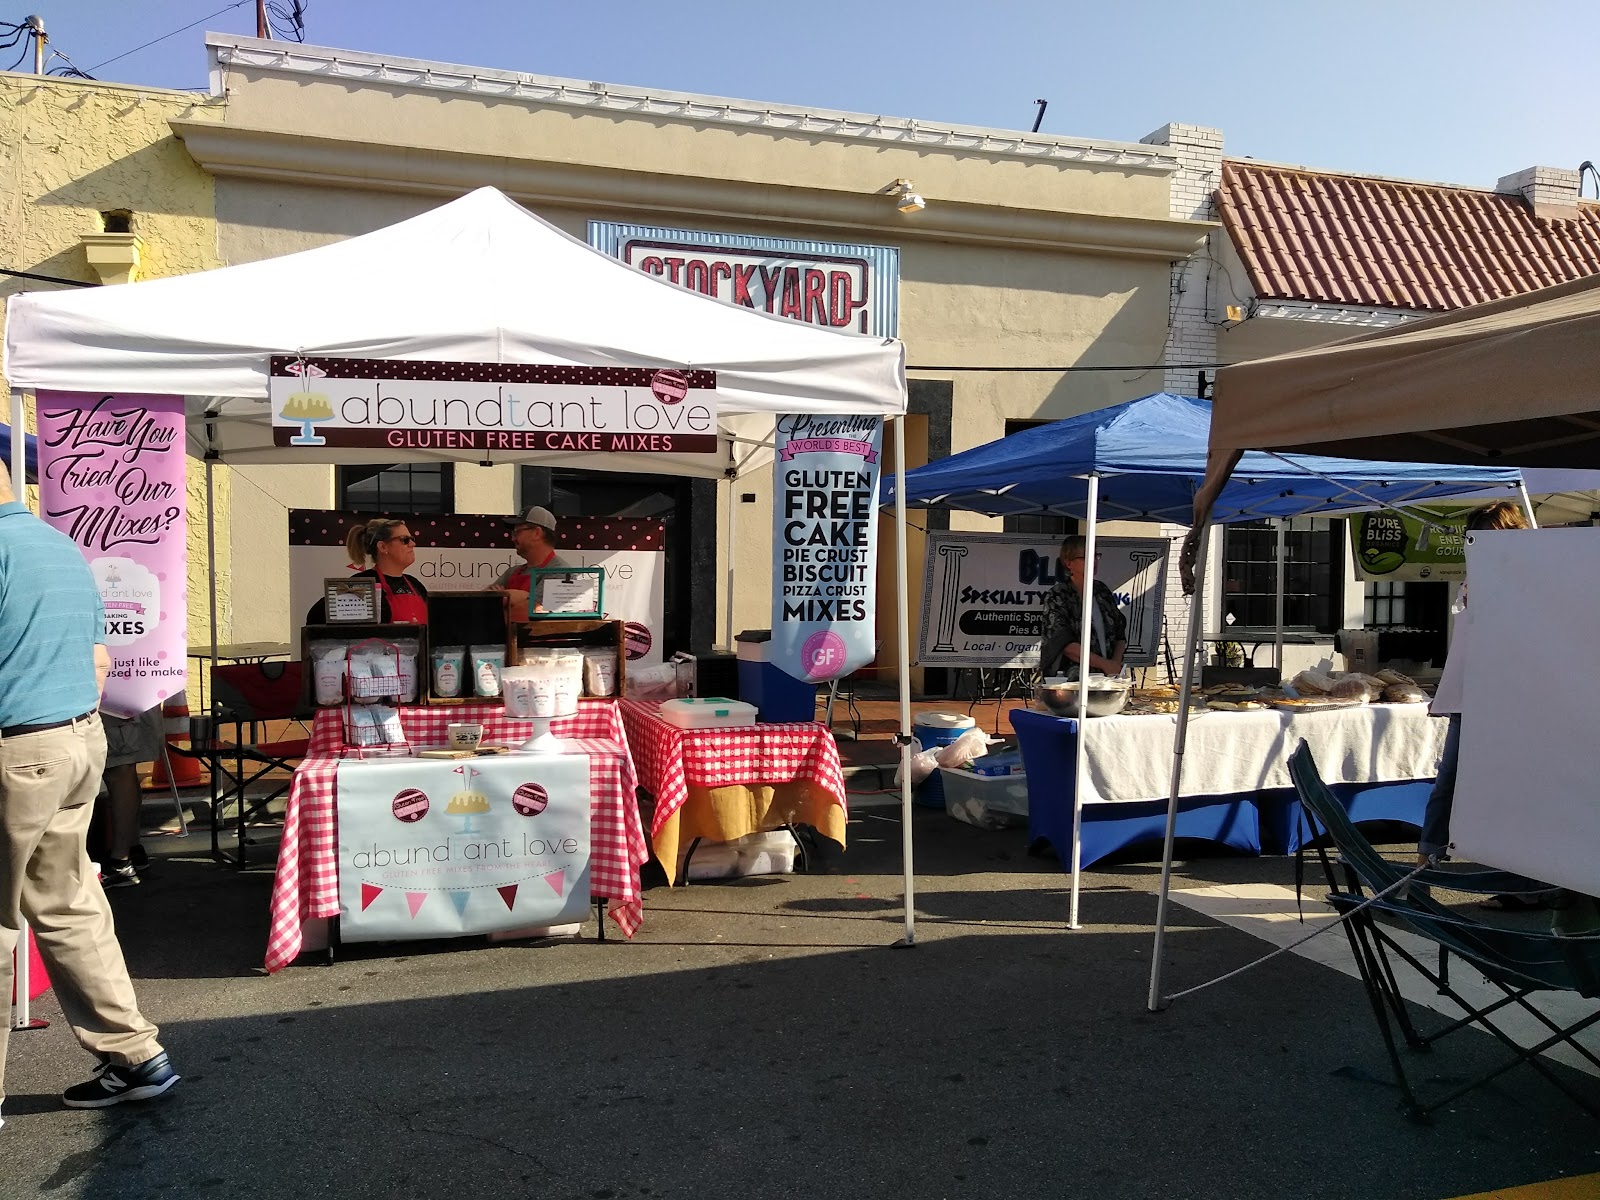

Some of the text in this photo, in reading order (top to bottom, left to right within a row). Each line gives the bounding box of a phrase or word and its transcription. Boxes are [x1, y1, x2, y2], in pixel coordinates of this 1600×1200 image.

[341, 382, 711, 432] abundtant love
[44, 396, 178, 463] Have You
[777, 413, 880, 442] Presenting
[387, 429, 673, 452] GLUTEN FREE CAKE MIXES
[791, 440, 868, 453] WORLD'S BEST
[46, 450, 177, 506] Tried Our
[785, 469, 871, 489] GLUTEN
[784, 490, 870, 519] FREE
[47, 505, 181, 552] Mixes?
[1368, 517, 1401, 529] PURE
[784, 521, 869, 547] CAKE
[784, 549, 868, 562] PIE CRUST
[1436, 546, 1465, 556] GOUR
[784, 564, 868, 583] BISCUIT
[133, 588, 153, 598] love
[428, 582, 456, 590] GLUTEN
[458, 582, 476, 590] FREE
[783, 586, 867, 597] PIZZA CRUST
[959, 585, 1050, 606] SPECIALTY
[783, 599, 866, 622] MIXES
[974, 611, 1022, 622] Authentic
[1008, 625, 1039, 635] Pies &
[963, 641, 996, 652] Local
[114, 657, 160, 669] just like
[811, 648, 835, 666] GF
[135, 668, 147, 677] to
[151, 667, 183, 677] make
[523, 832, 578, 857] love
[382, 860, 552, 880] GLUTEN FREE MIXES FROM THE HEART
